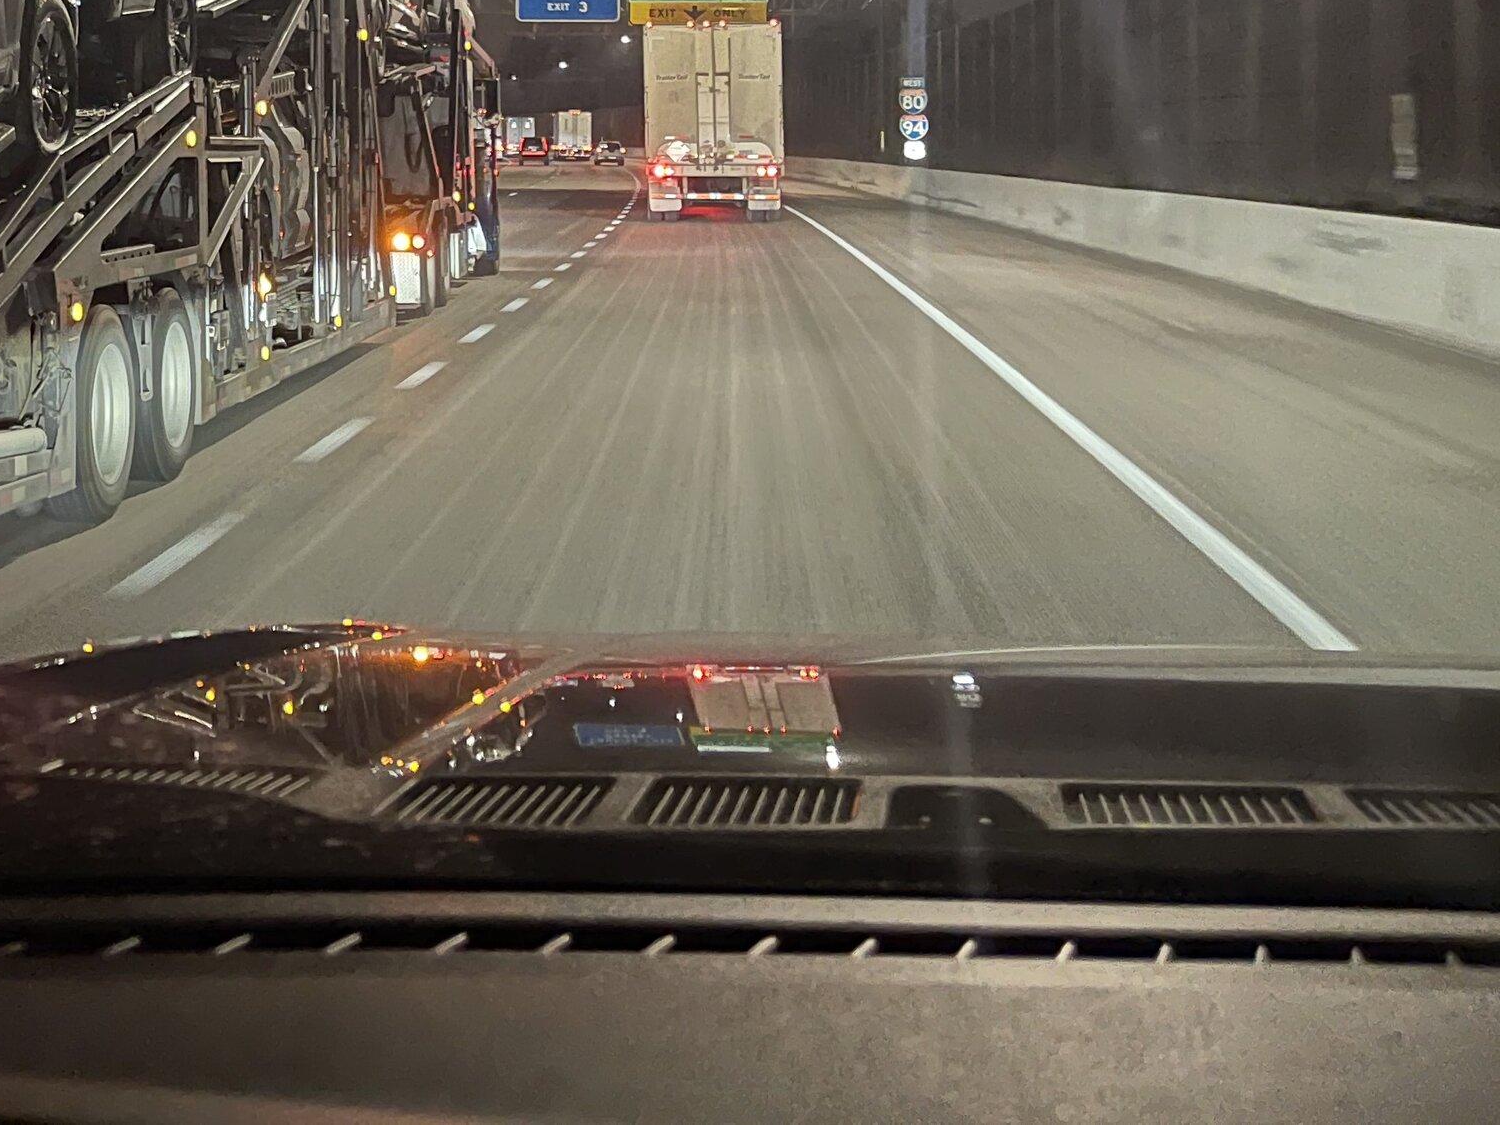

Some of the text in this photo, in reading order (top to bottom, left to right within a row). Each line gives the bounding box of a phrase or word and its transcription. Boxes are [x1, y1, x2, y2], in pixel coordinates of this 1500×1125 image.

[547, 1, 588, 13] EXIT 3
[649, 8, 747, 19] EXIT ONLY
[903, 95, 924, 109] 80
[903, 121, 925, 135] 94
